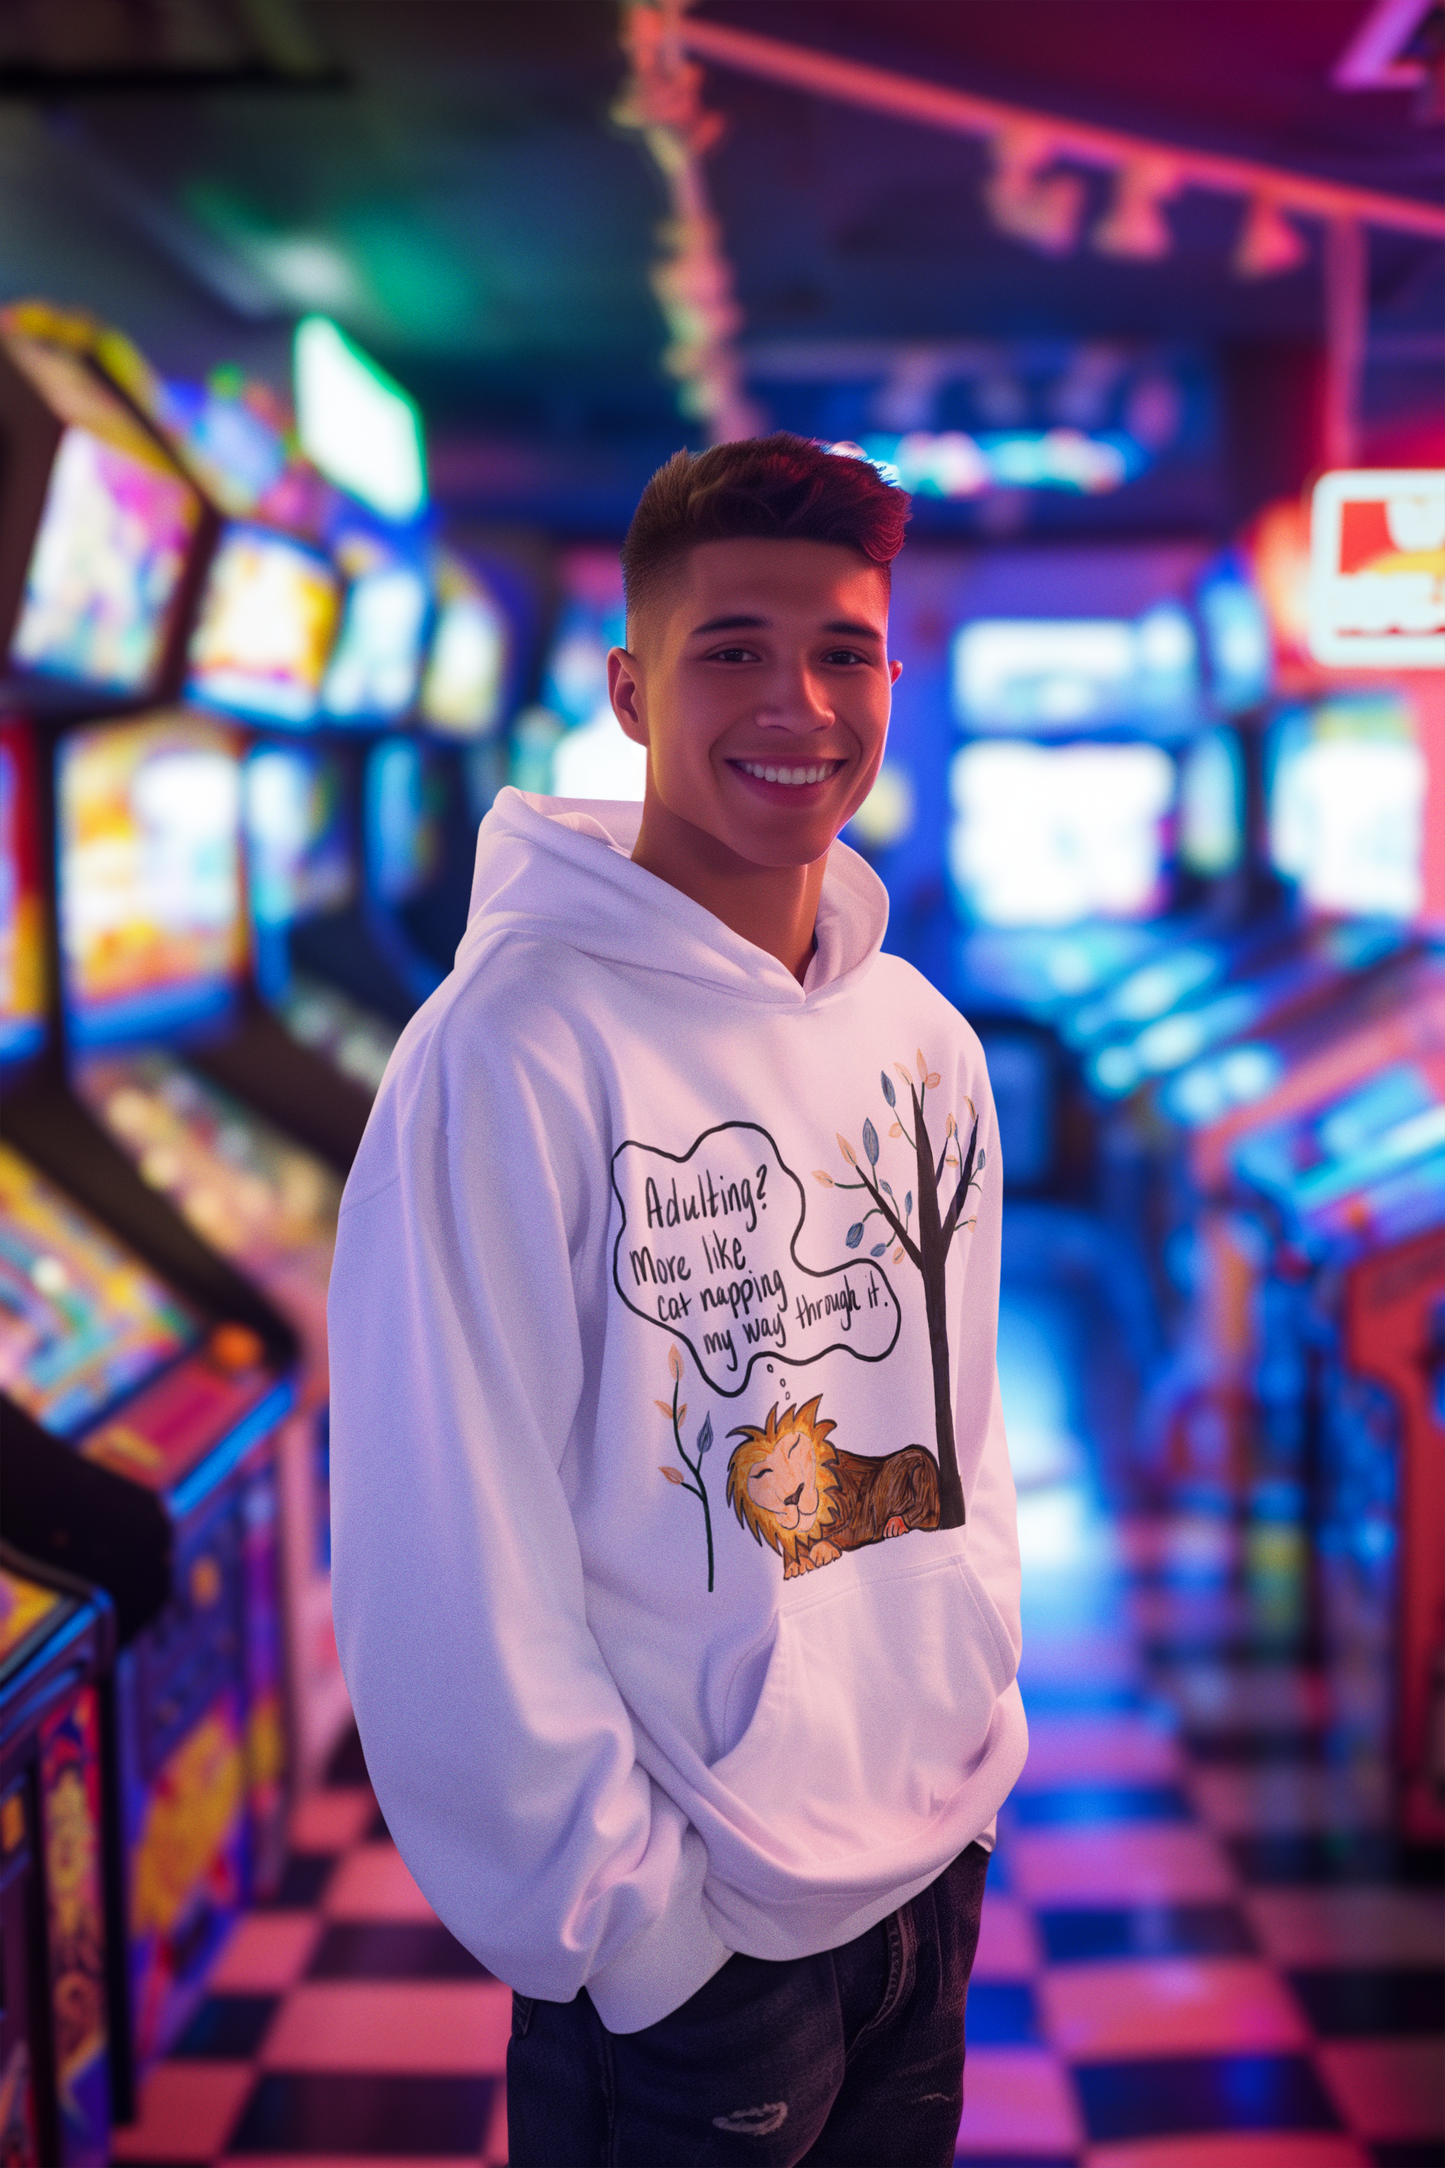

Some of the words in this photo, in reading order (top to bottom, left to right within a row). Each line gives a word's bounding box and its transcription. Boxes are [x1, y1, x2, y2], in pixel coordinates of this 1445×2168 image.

[645, 1163, 768, 1233] Adulting?
[629, 1246, 691, 1286] More
[702, 1229, 746, 1275] like
[657, 1292, 692, 1322] cat
[700, 1269, 788, 1319] napping
[703, 1329, 738, 1372] my
[742, 1312, 787, 1349] way
[795, 1274, 862, 1332] through
[864, 1270, 889, 1309] it.
